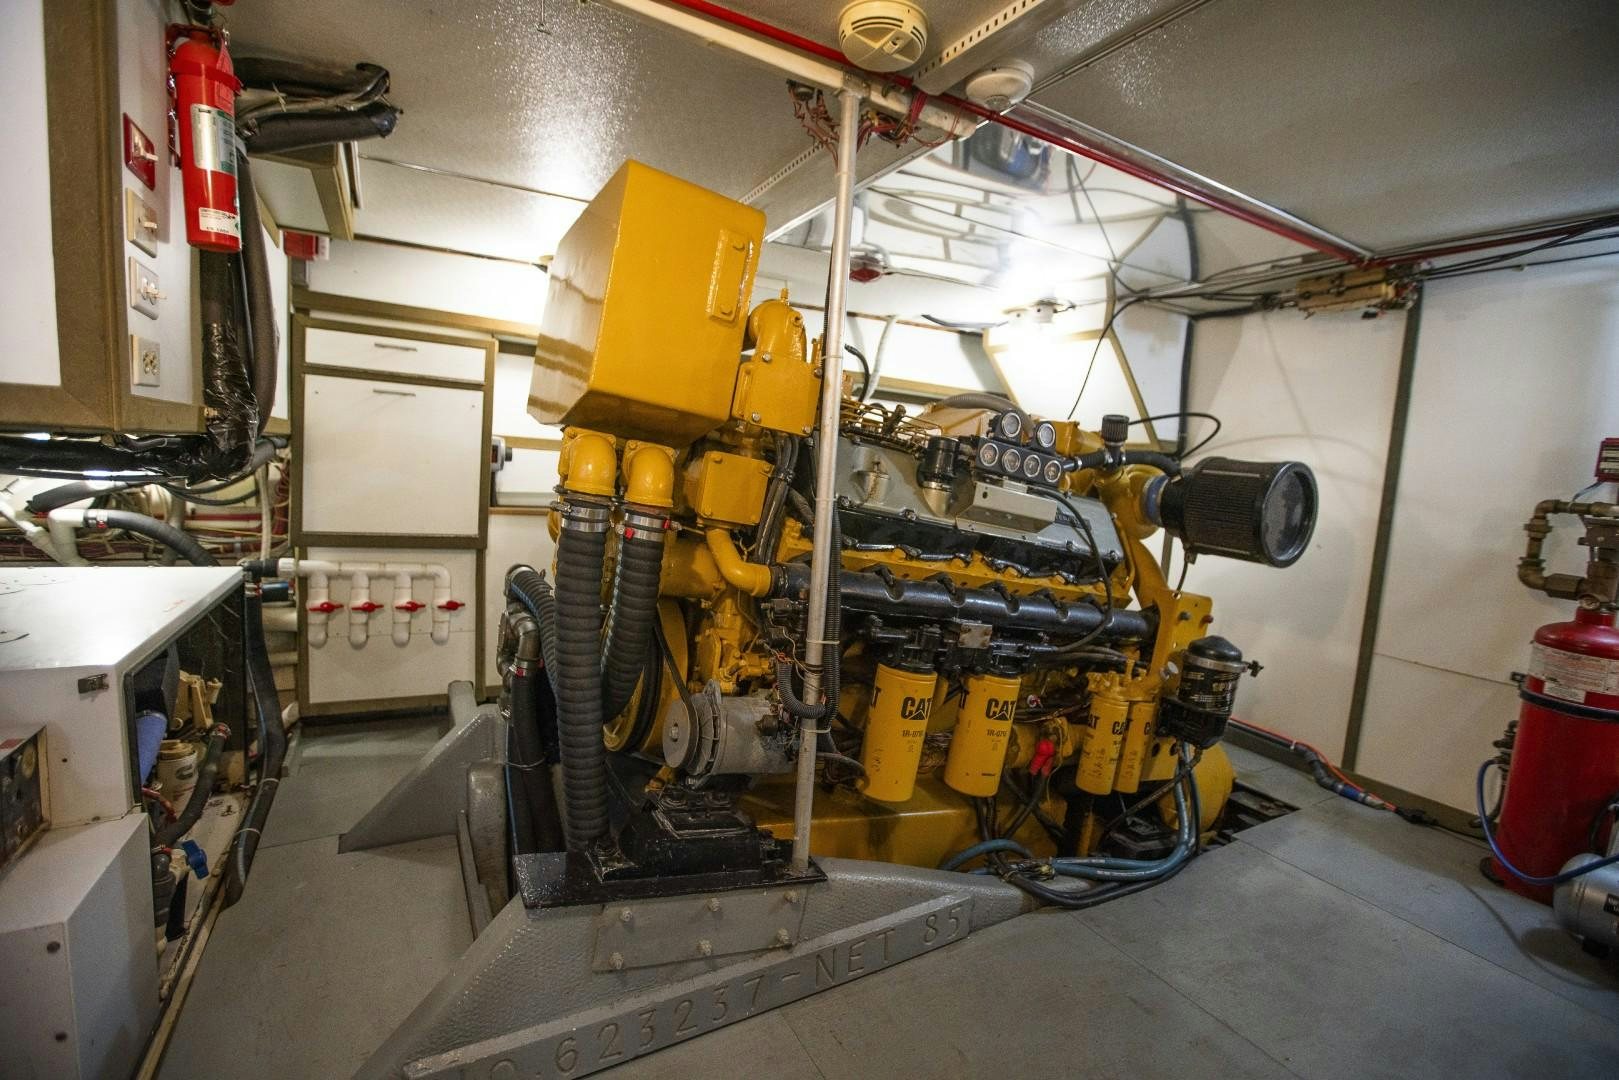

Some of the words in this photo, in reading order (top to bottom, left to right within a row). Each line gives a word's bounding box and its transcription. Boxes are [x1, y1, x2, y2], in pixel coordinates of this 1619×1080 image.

[901, 696, 932, 720] CAT
[985, 697, 1016, 721] CAT
[923, 903, 963, 946] 85
